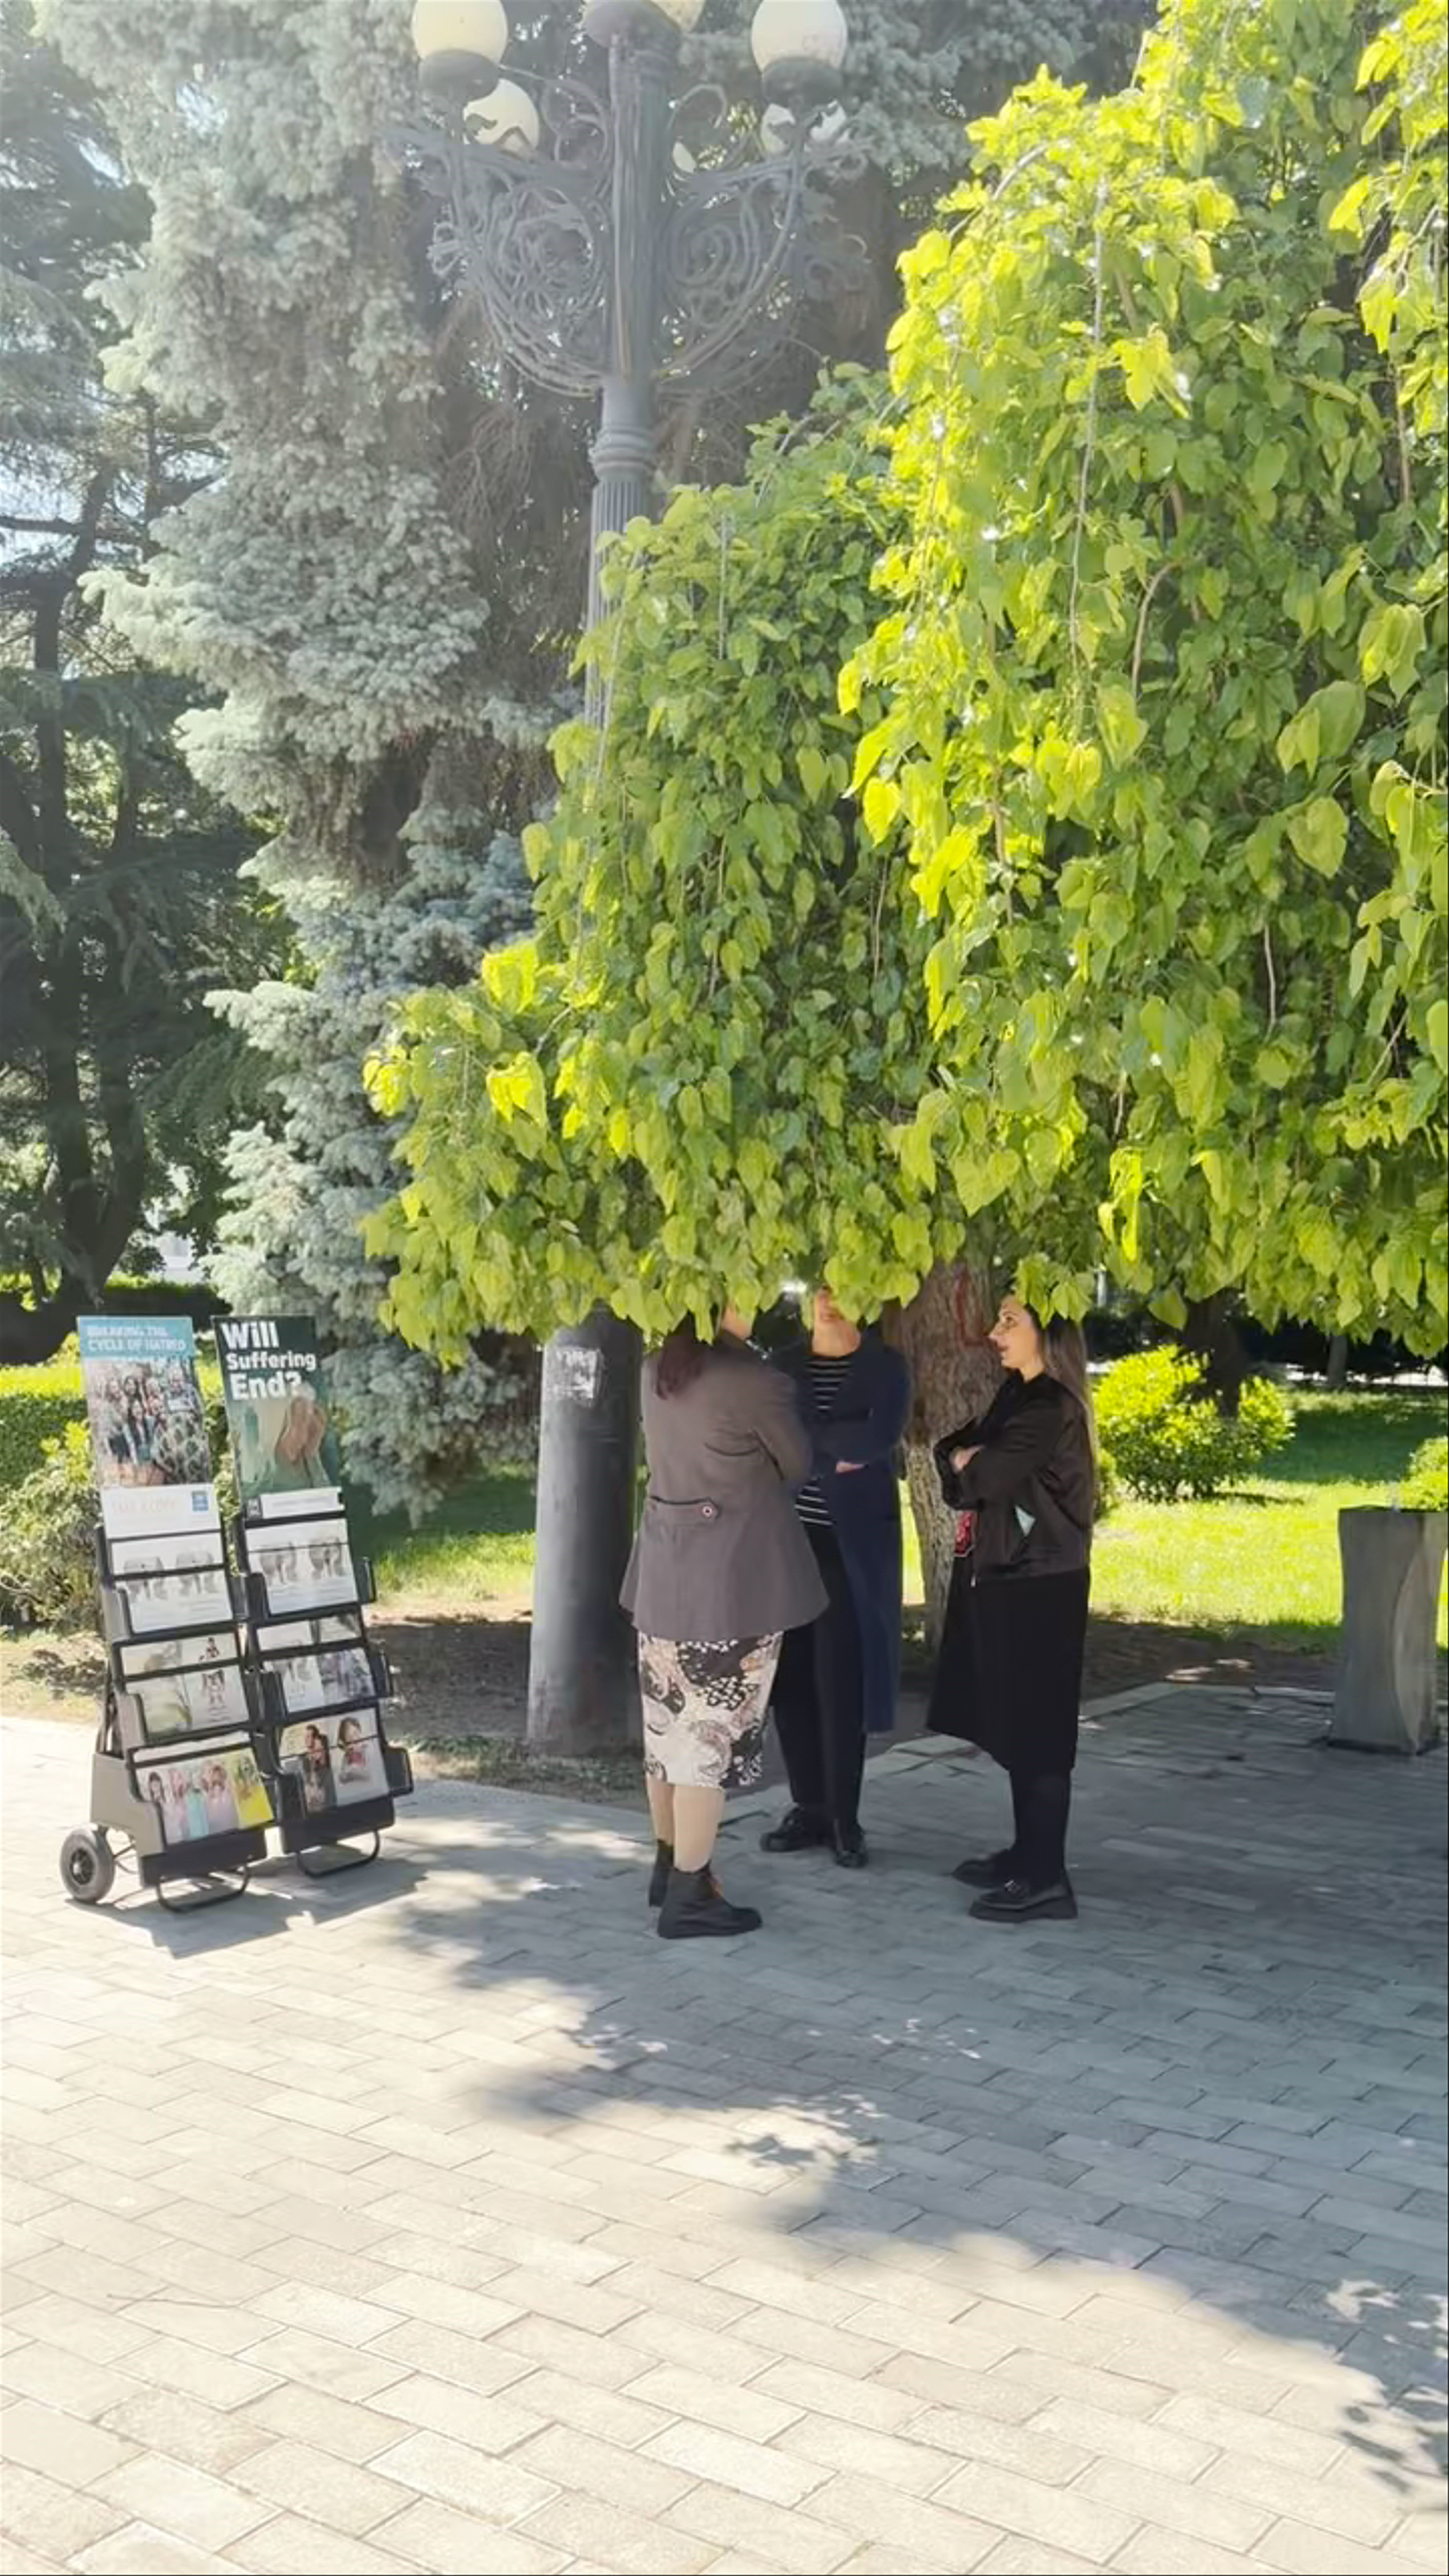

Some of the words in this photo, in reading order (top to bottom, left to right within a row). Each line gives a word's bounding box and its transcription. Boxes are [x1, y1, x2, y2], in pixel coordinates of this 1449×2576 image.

[220, 1321, 279, 1350] Will
[226, 1349, 316, 1372] Suffering
[230, 1370, 301, 1400] End?
